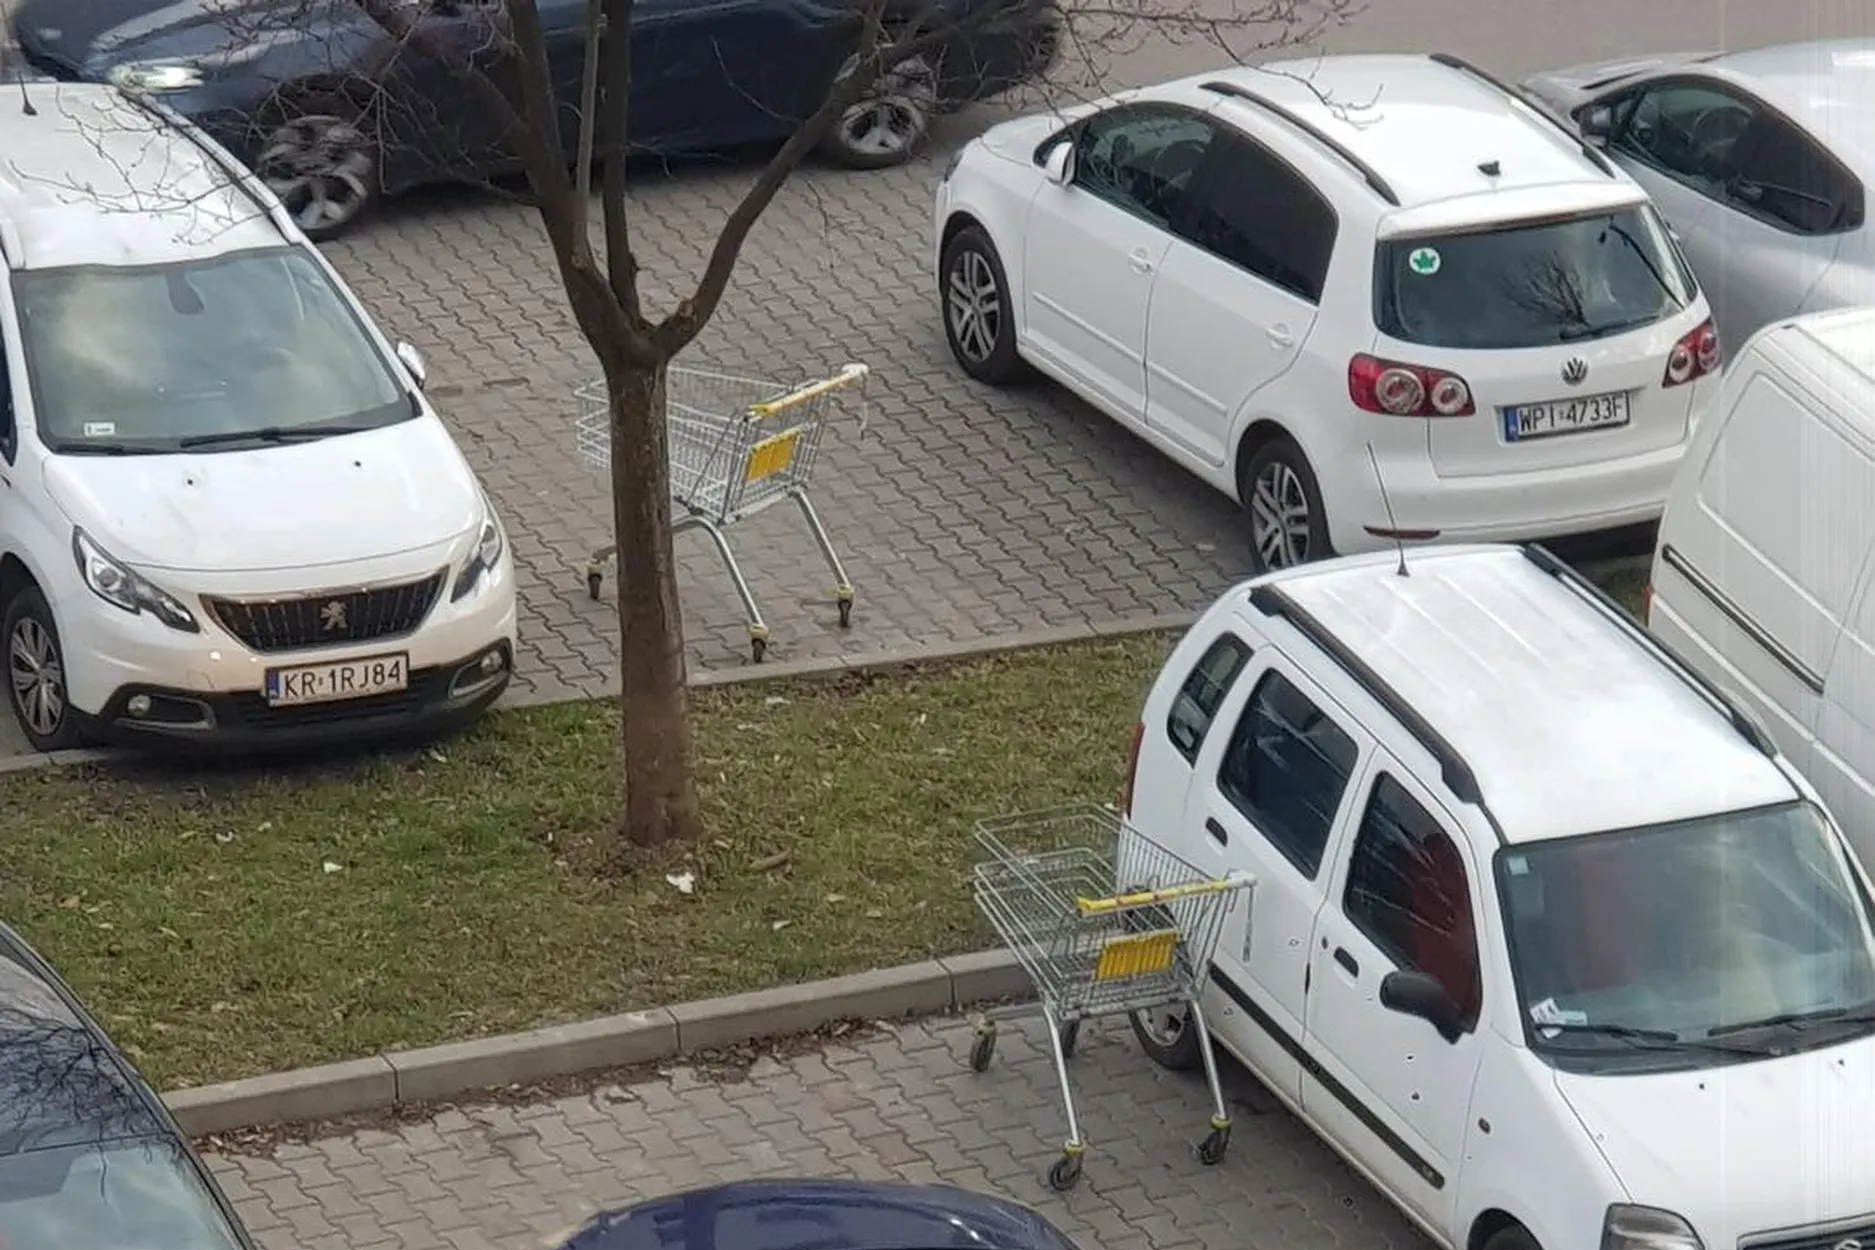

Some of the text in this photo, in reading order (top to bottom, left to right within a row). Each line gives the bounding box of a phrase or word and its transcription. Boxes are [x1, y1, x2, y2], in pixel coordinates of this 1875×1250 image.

[1519, 396, 1623, 432] WPI 4733F
[284, 660, 401, 698] KR 1RJ84
